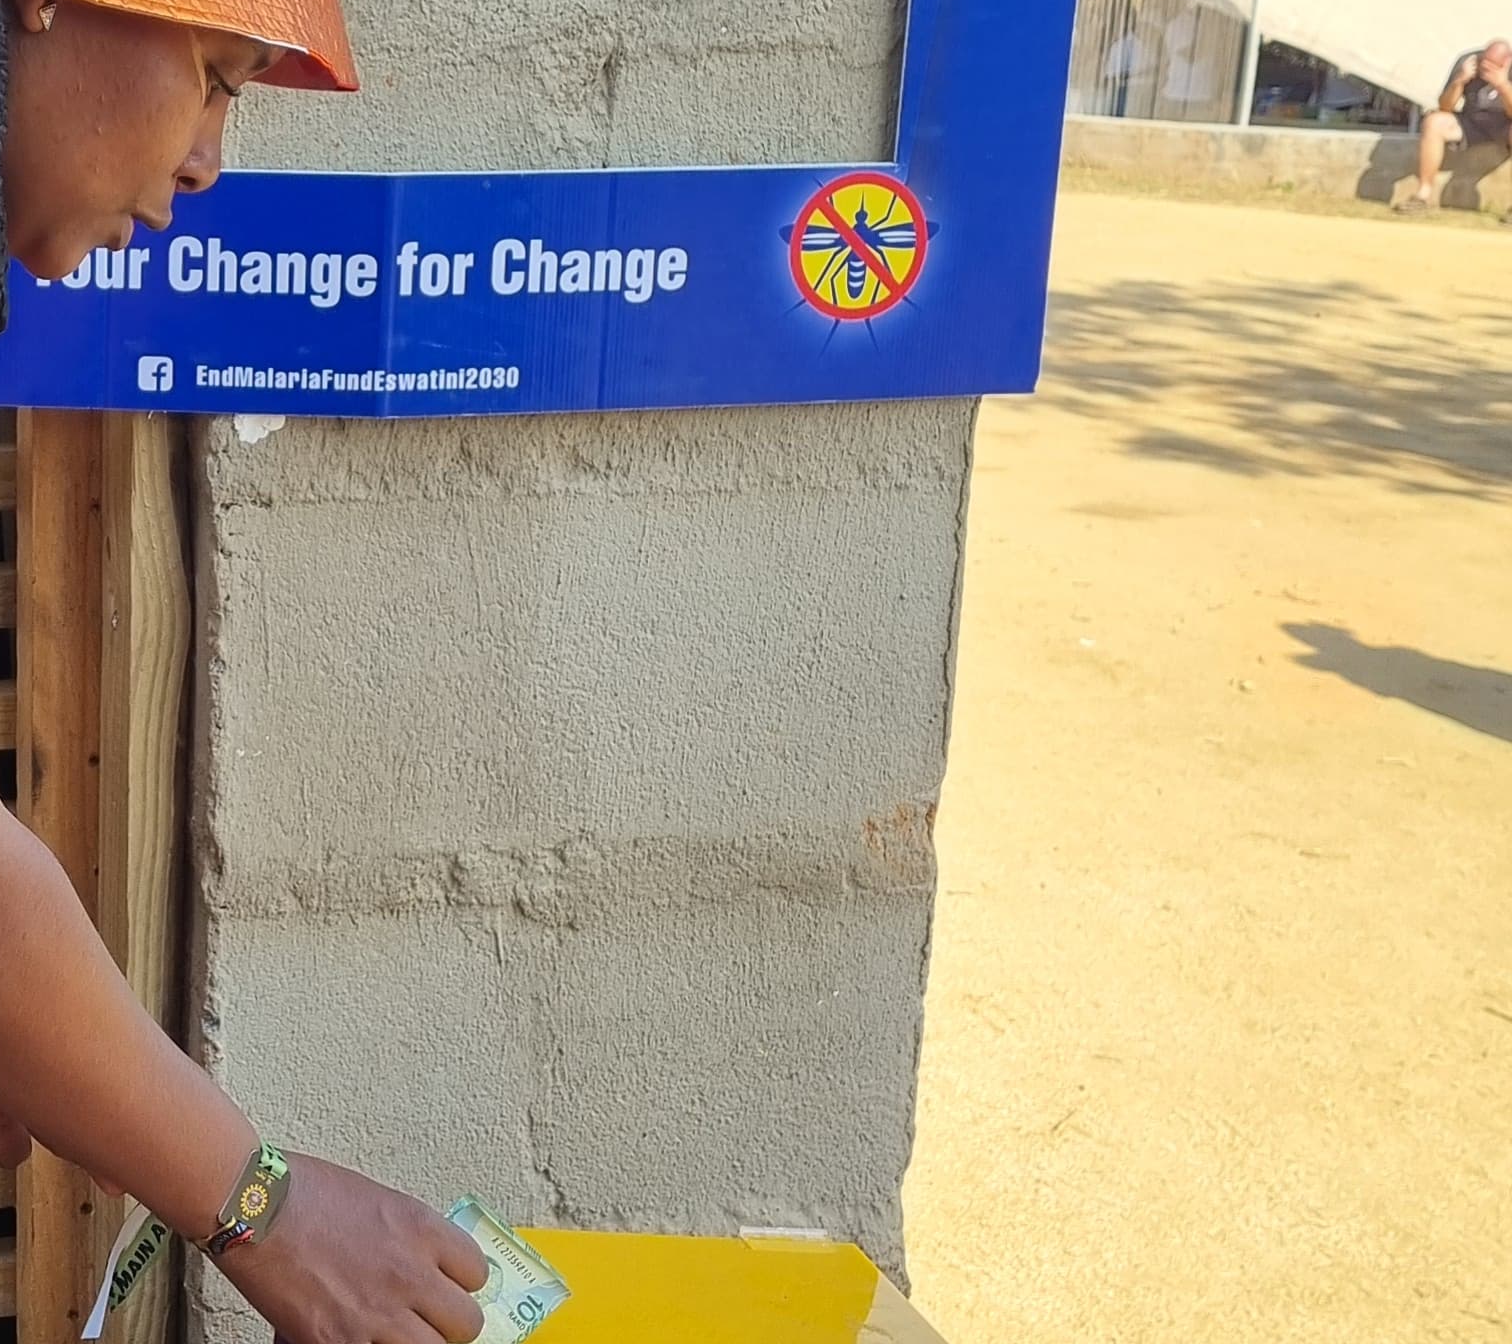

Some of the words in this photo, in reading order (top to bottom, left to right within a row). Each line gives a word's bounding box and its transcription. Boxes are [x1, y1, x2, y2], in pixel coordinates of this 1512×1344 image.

[37, 247, 149, 289] our
[168, 235, 378, 308] Change
[396, 242, 474, 296] for
[491, 238, 688, 303] Change
[196, 365, 520, 392] EndMalariaFundEswatini2030
[517, 1294, 544, 1323] 10
